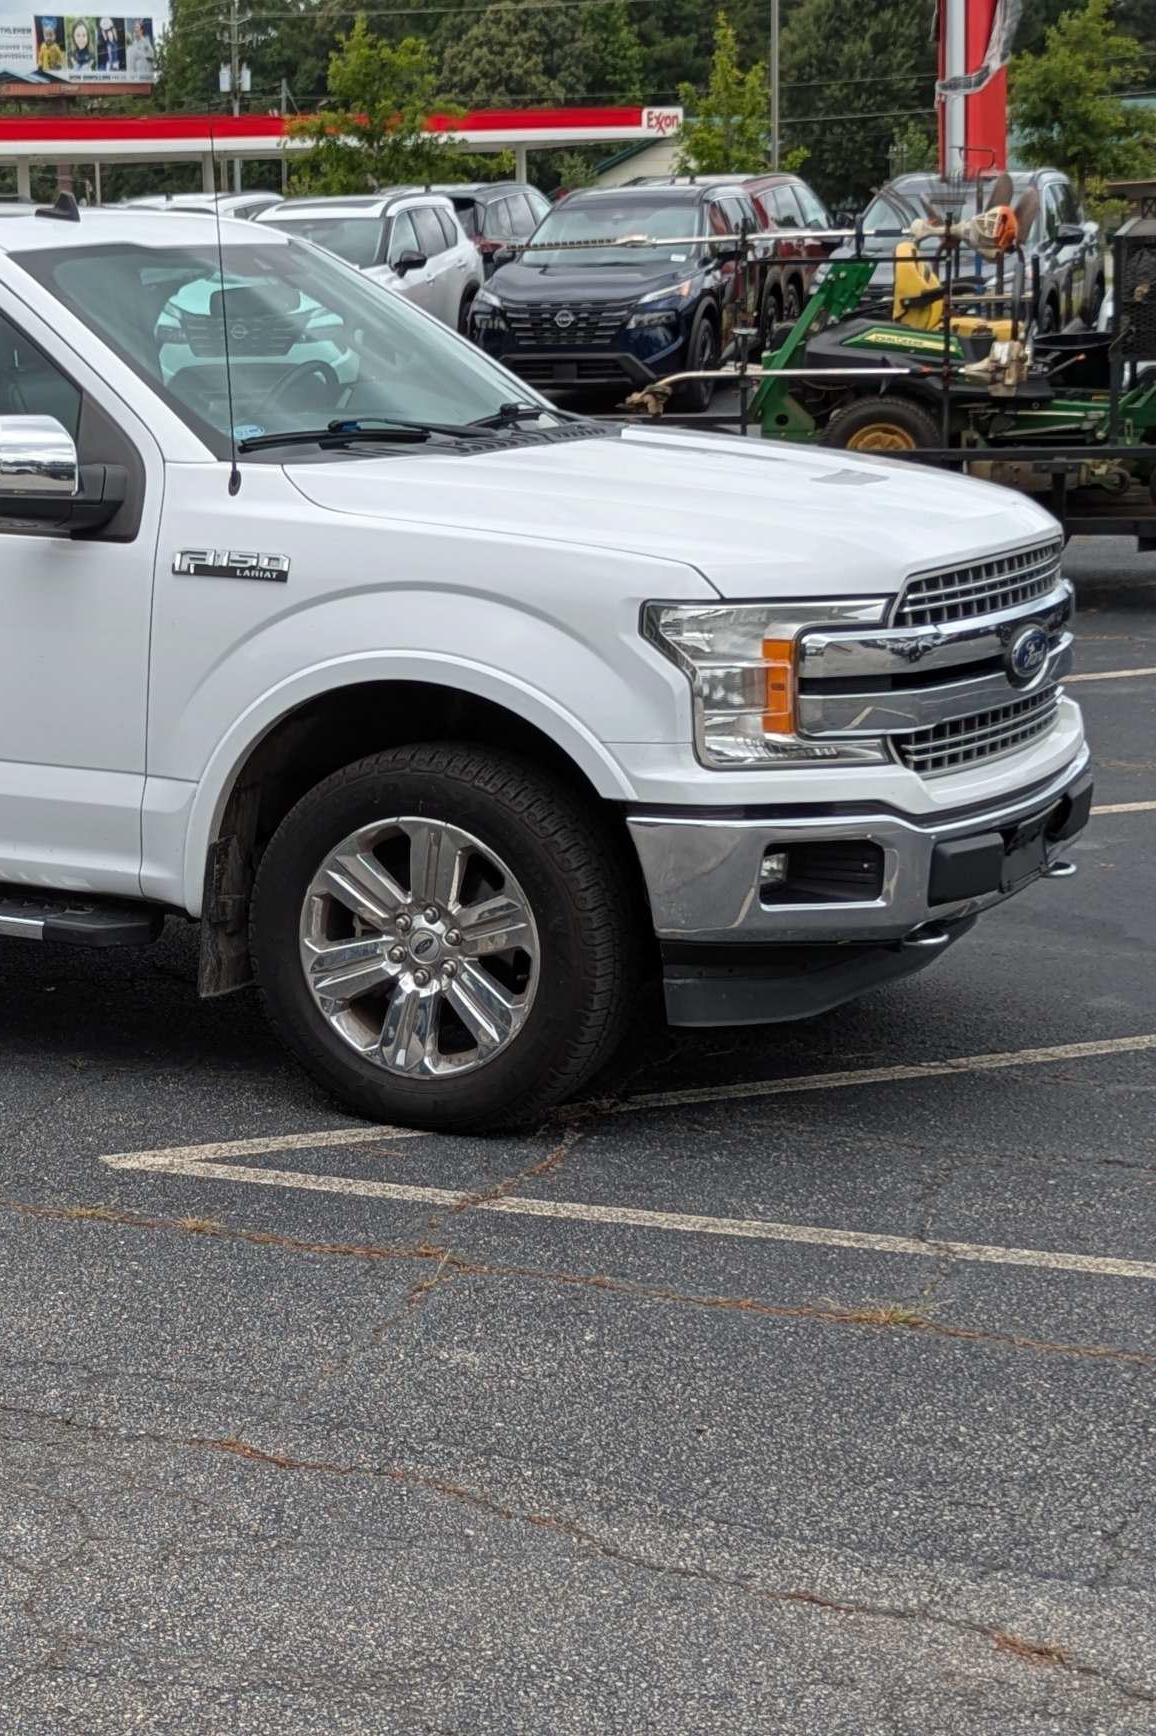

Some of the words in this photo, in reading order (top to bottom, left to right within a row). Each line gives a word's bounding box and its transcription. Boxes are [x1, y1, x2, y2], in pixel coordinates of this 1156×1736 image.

[647, 110, 680, 135] Exxon
[236, 568, 279, 579] LARIAT
[1023, 640, 1046, 668] Ford
